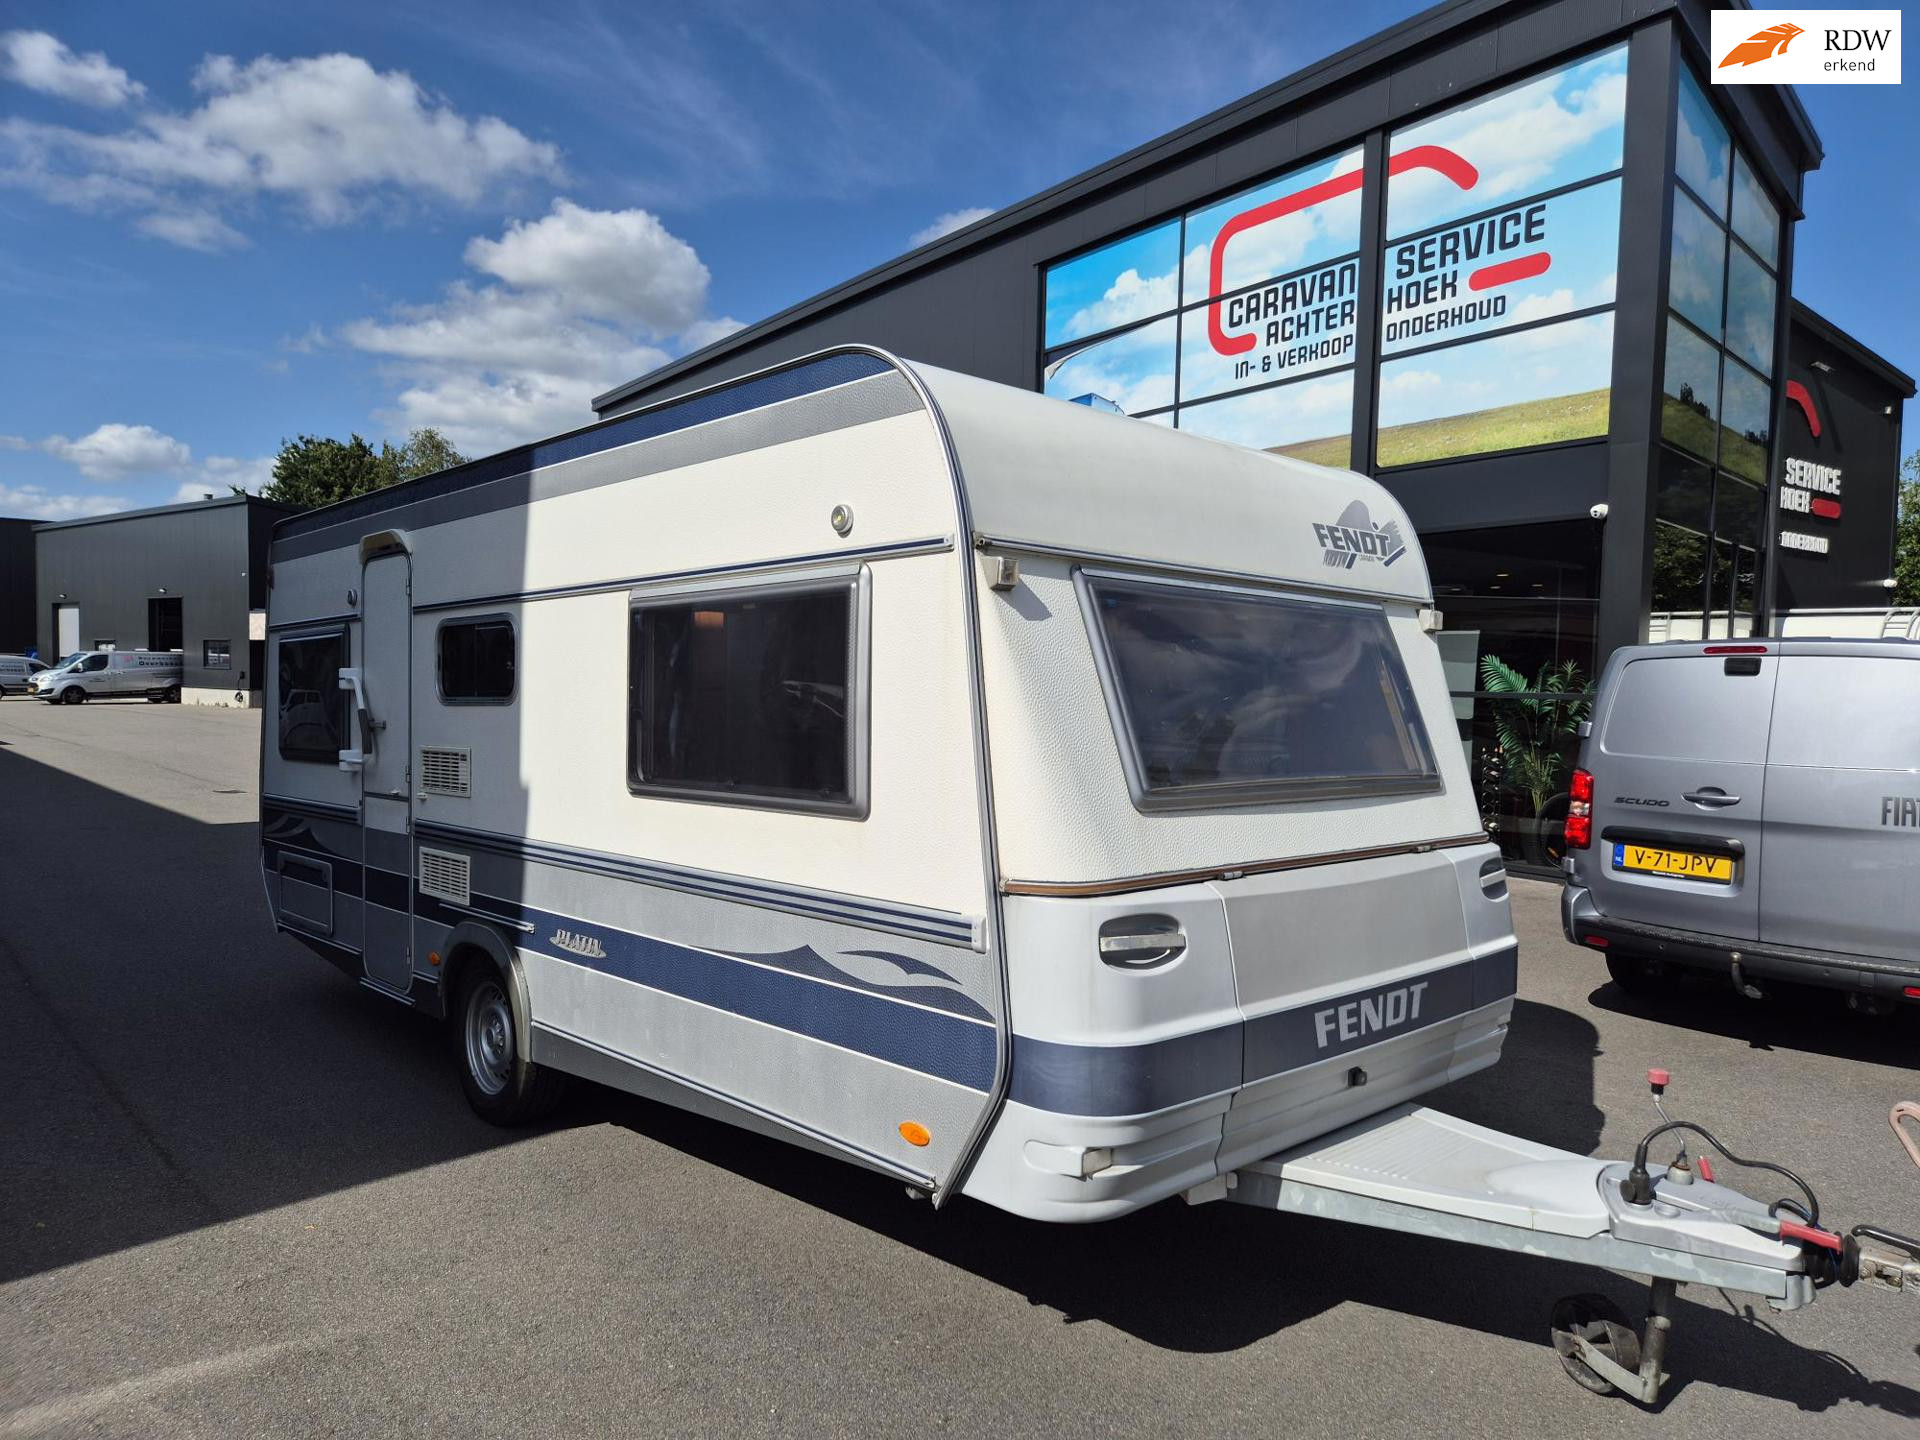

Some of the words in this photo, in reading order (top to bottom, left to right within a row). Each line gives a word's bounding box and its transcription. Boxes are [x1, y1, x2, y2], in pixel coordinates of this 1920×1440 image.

[1228, 262, 1357, 329] CARAVAN
[1396, 203, 1546, 280] SERVICE
[1265, 299, 1355, 347] ACHTER
[1386, 270, 1458, 315] HOEK
[1235, 362, 1256, 380] IN-
[1261, 355, 1271, 373] &
[1277, 333, 1354, 369] VERKOOP
[1386, 295, 1506, 342] ONDERHOUD
[1784, 457, 1842, 495] SERVICE
[1780, 486, 1811, 514] HOEK
[1312, 522, 1389, 557] FENDT
[1613, 796, 1670, 807] SCUDO
[1635, 849, 1717, 874] V-71-JPV
[1314, 981, 1428, 1049] FENDT
